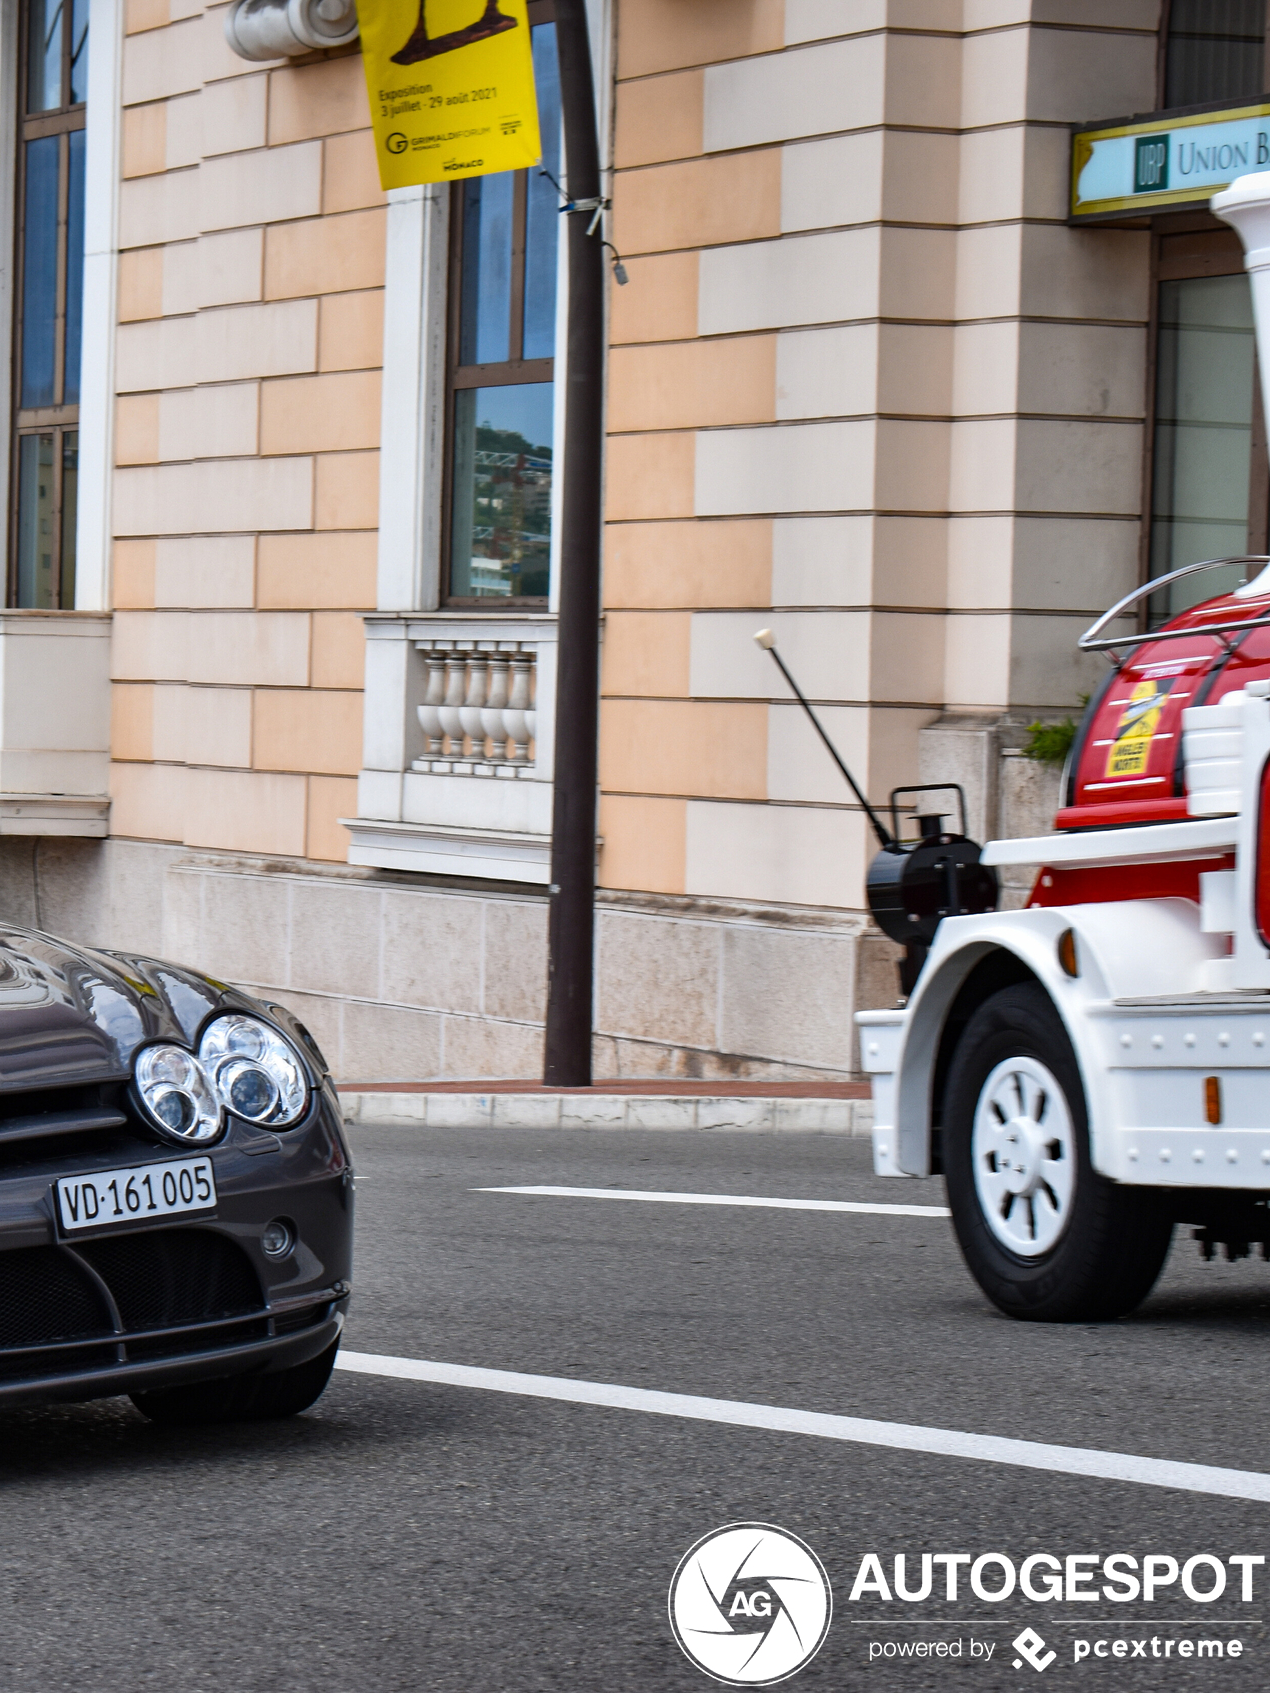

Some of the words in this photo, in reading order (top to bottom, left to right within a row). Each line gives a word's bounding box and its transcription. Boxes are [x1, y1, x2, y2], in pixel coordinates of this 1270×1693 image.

[378, 84, 433, 102] Exposition
[381, 105, 388, 117] 3
[390, 101, 421, 119] juillet
[428, 95, 443, 108] 29
[445, 92, 469, 105] août
[471, 87, 497, 101] 2021
[443, 159, 484, 172] MONACO
[1138, 142, 1166, 186] UBP
[1178, 142, 1248, 175] UNION
